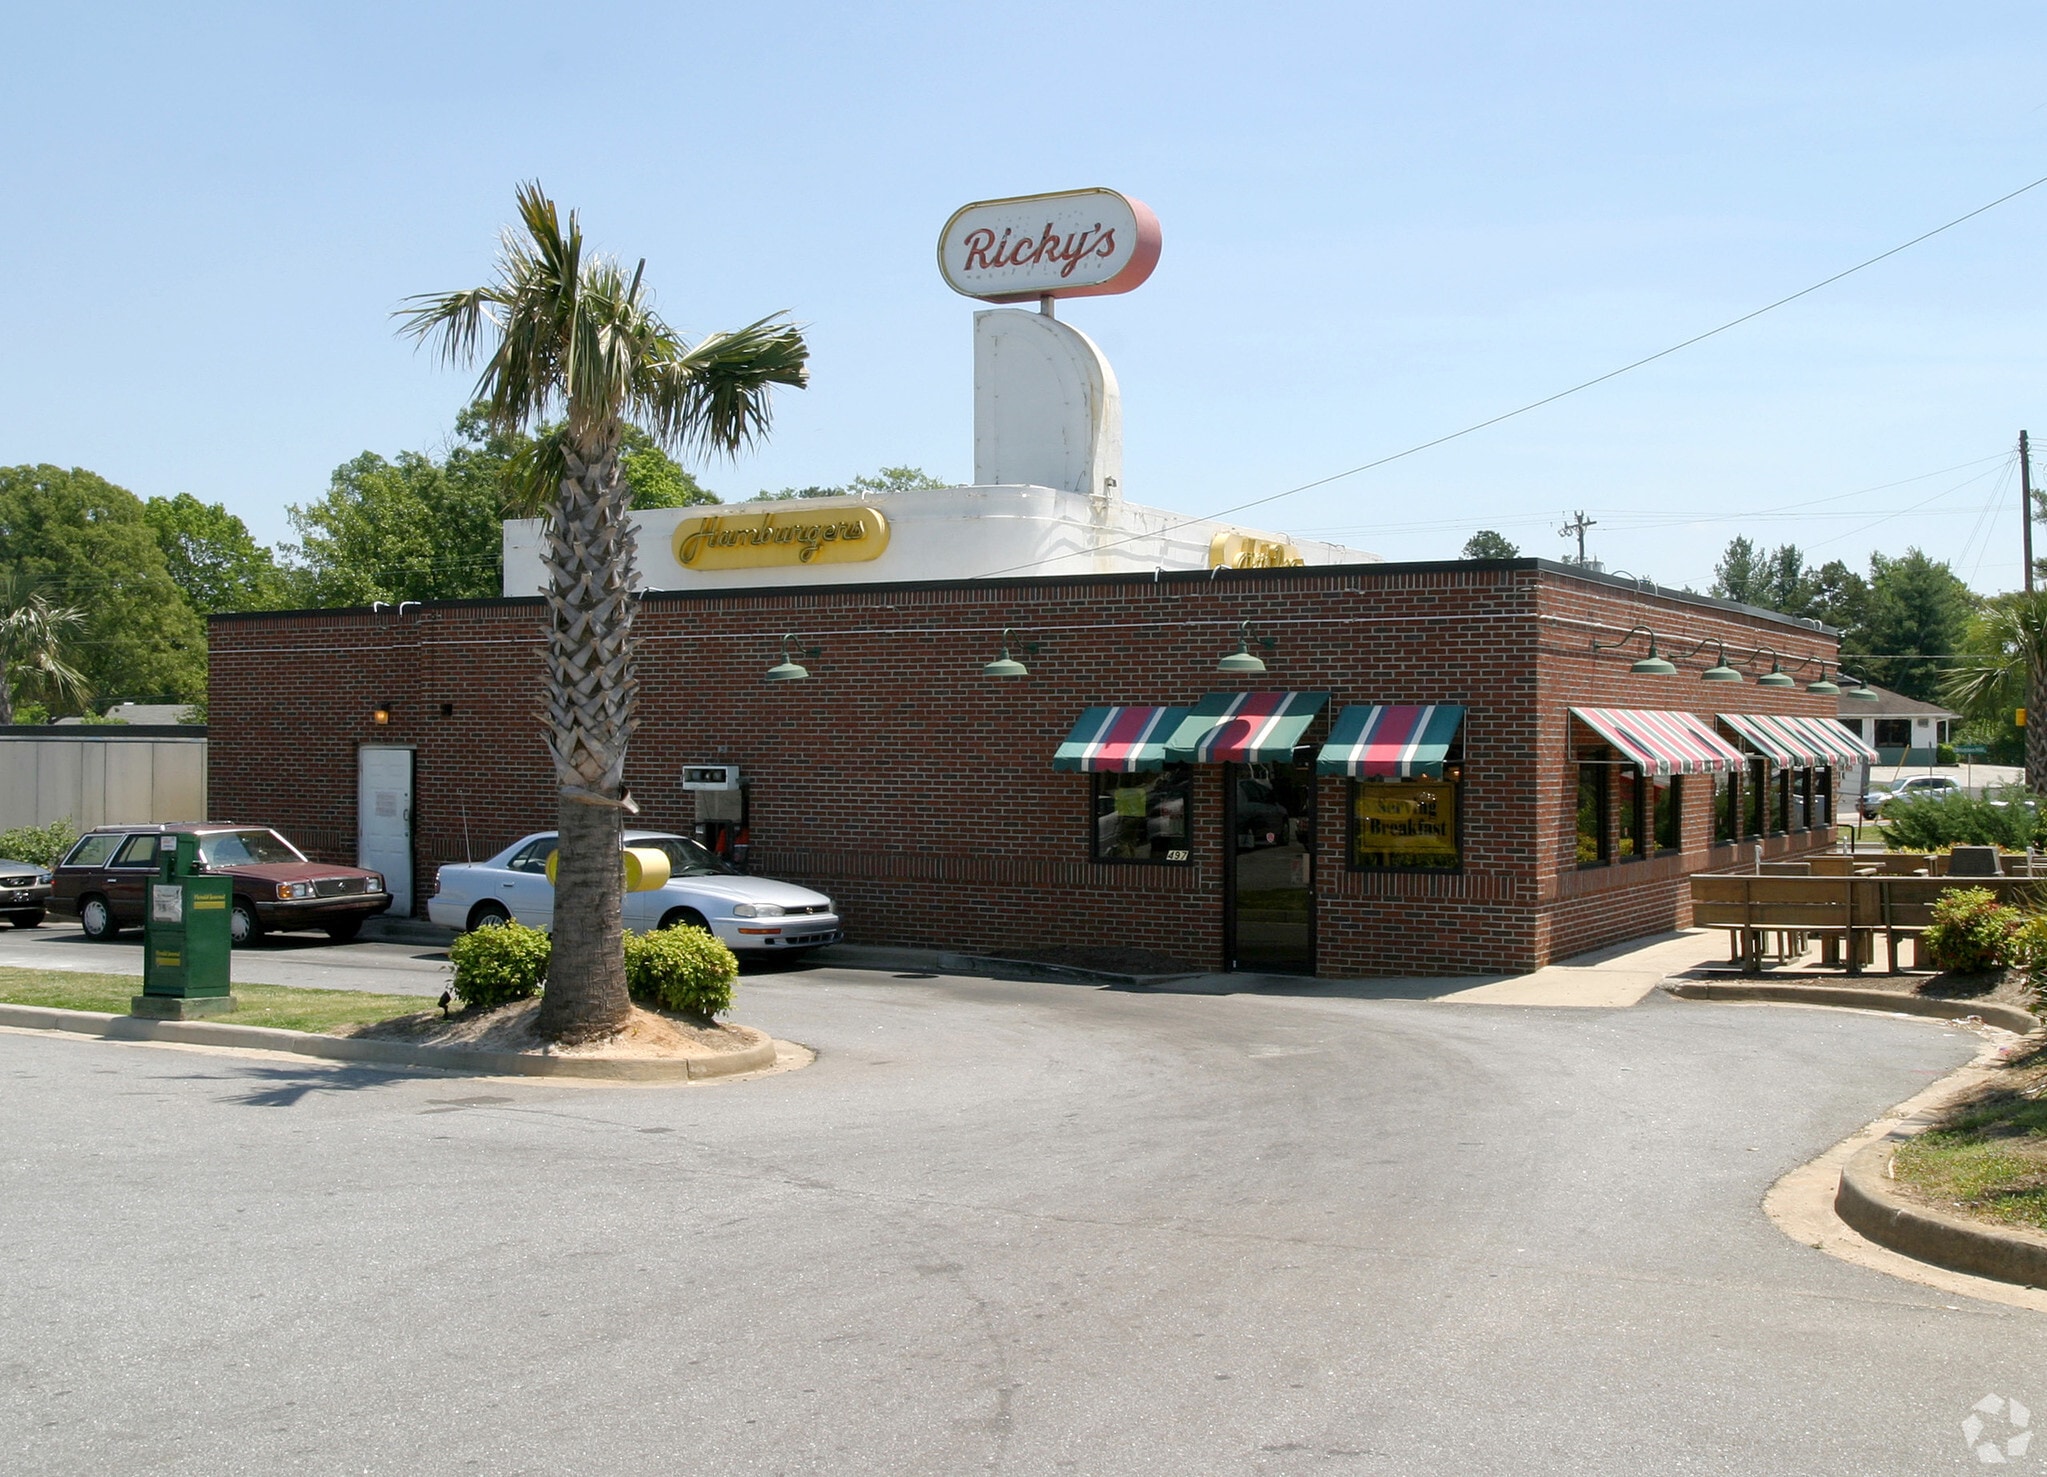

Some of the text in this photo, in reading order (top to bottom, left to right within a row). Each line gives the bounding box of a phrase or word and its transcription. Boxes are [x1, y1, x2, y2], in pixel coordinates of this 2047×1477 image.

[963, 222, 1116, 278] Ricky's
[679, 512, 866, 563] Hamburgers
[1370, 818, 1446, 836] Breakfast
[1167, 851, 1188, 860] 497
